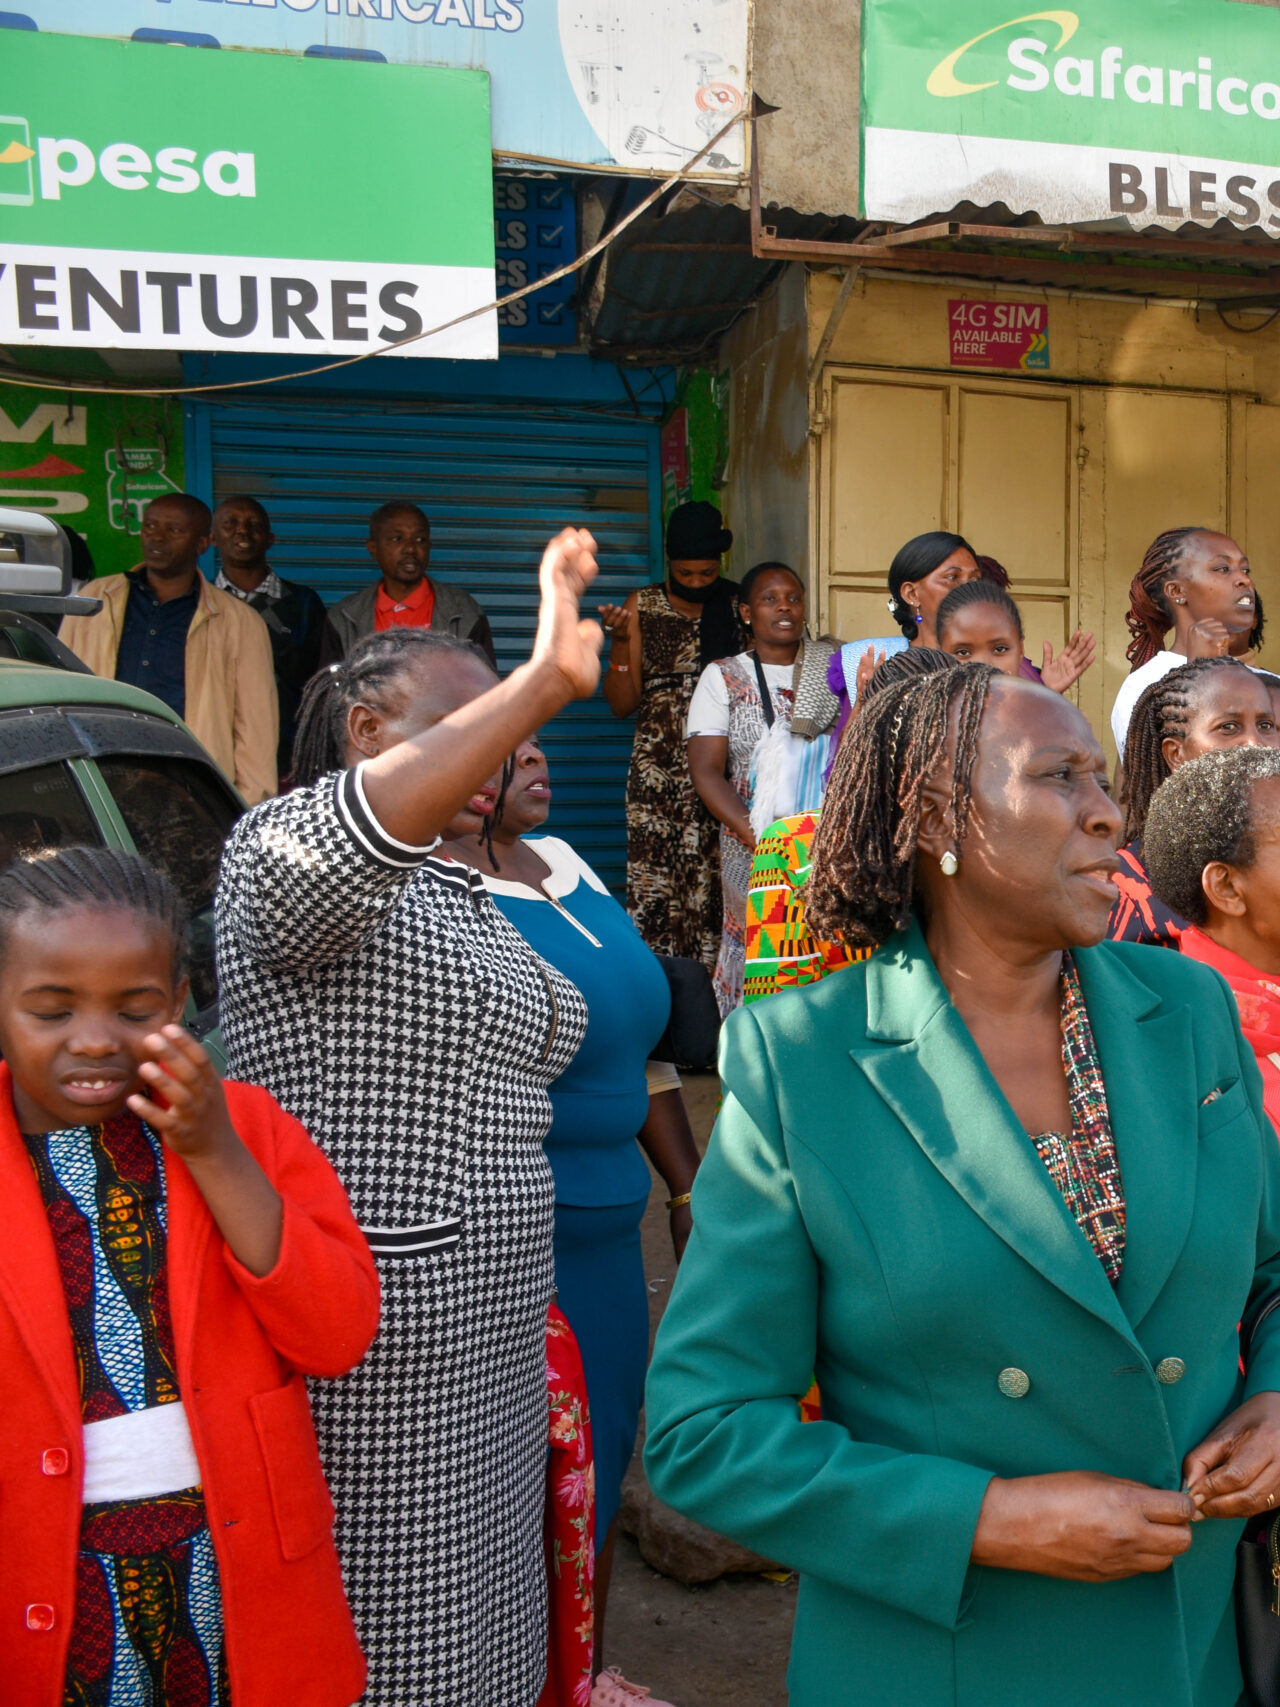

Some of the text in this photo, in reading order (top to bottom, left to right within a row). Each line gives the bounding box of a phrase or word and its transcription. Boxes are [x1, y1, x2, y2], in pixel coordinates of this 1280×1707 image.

[0, 263, 424, 343] ENTURES
[952, 303, 1041, 330] 4G SIM
[952, 329, 1023, 344] AVAILABLE
[953, 342, 987, 355] HERE
